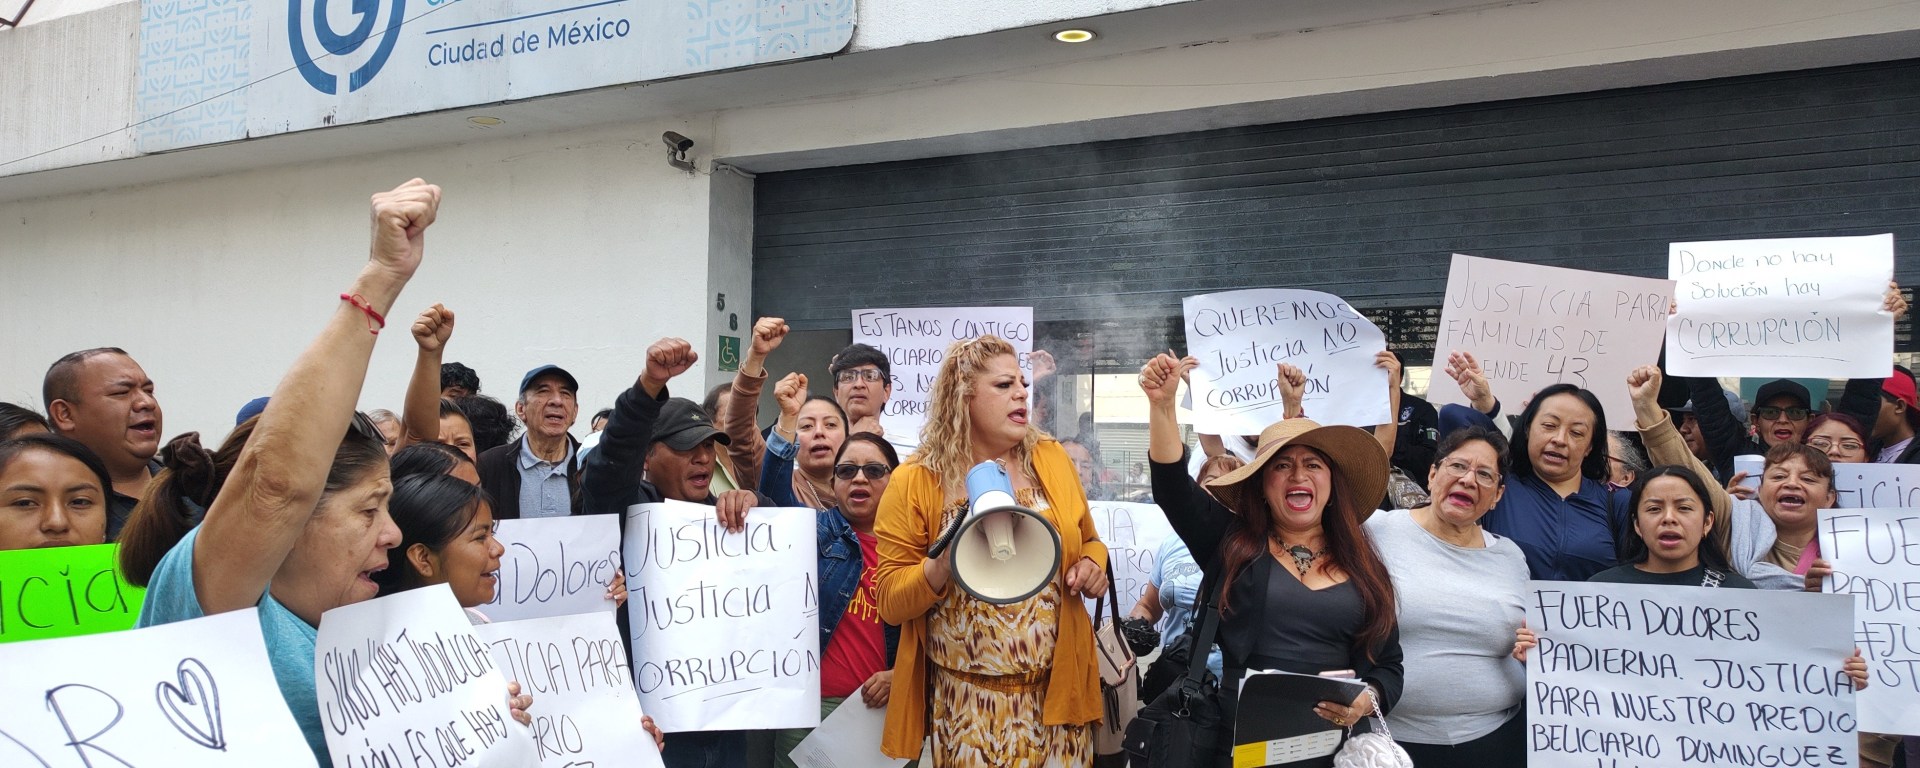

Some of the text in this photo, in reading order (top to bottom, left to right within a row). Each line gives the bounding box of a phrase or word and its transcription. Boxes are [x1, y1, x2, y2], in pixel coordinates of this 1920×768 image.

[428, 17, 631, 67] Ciudad de México
[1756, 254, 1783, 267] no
[1792, 250, 1834, 266] hay
[716, 292, 726, 312] 5
[1451, 258, 1668, 322] JUSTICIA PARA
[1785, 277, 1821, 297] hay
[859, 312, 1030, 342] ESTAMOS CONTIGO
[1194, 300, 1360, 338] QUEREMOS
[1323, 320, 1357, 351] NO
[1446, 317, 1609, 355] FAMILIAS DE
[872, 344, 943, 366] ICIARIO
[1546, 353, 1591, 390] 43
[1206, 364, 1331, 408] CORRUPÓN
[511, 540, 619, 605] Dolores
[1533, 589, 1761, 642] FUERA DOLORES
[572, 636, 634, 693] PARA
[637, 626, 819, 694] ORRUPCIÓN
[1537, 637, 1853, 698] PADIERNA. JUSTICIA
[1535, 681, 1857, 734] PARA NUESTRO PREDIO
[434, 720, 475, 768] QUE
[460, 704, 508, 750] HAY
[1531, 723, 1661, 759] BELICIARIO
